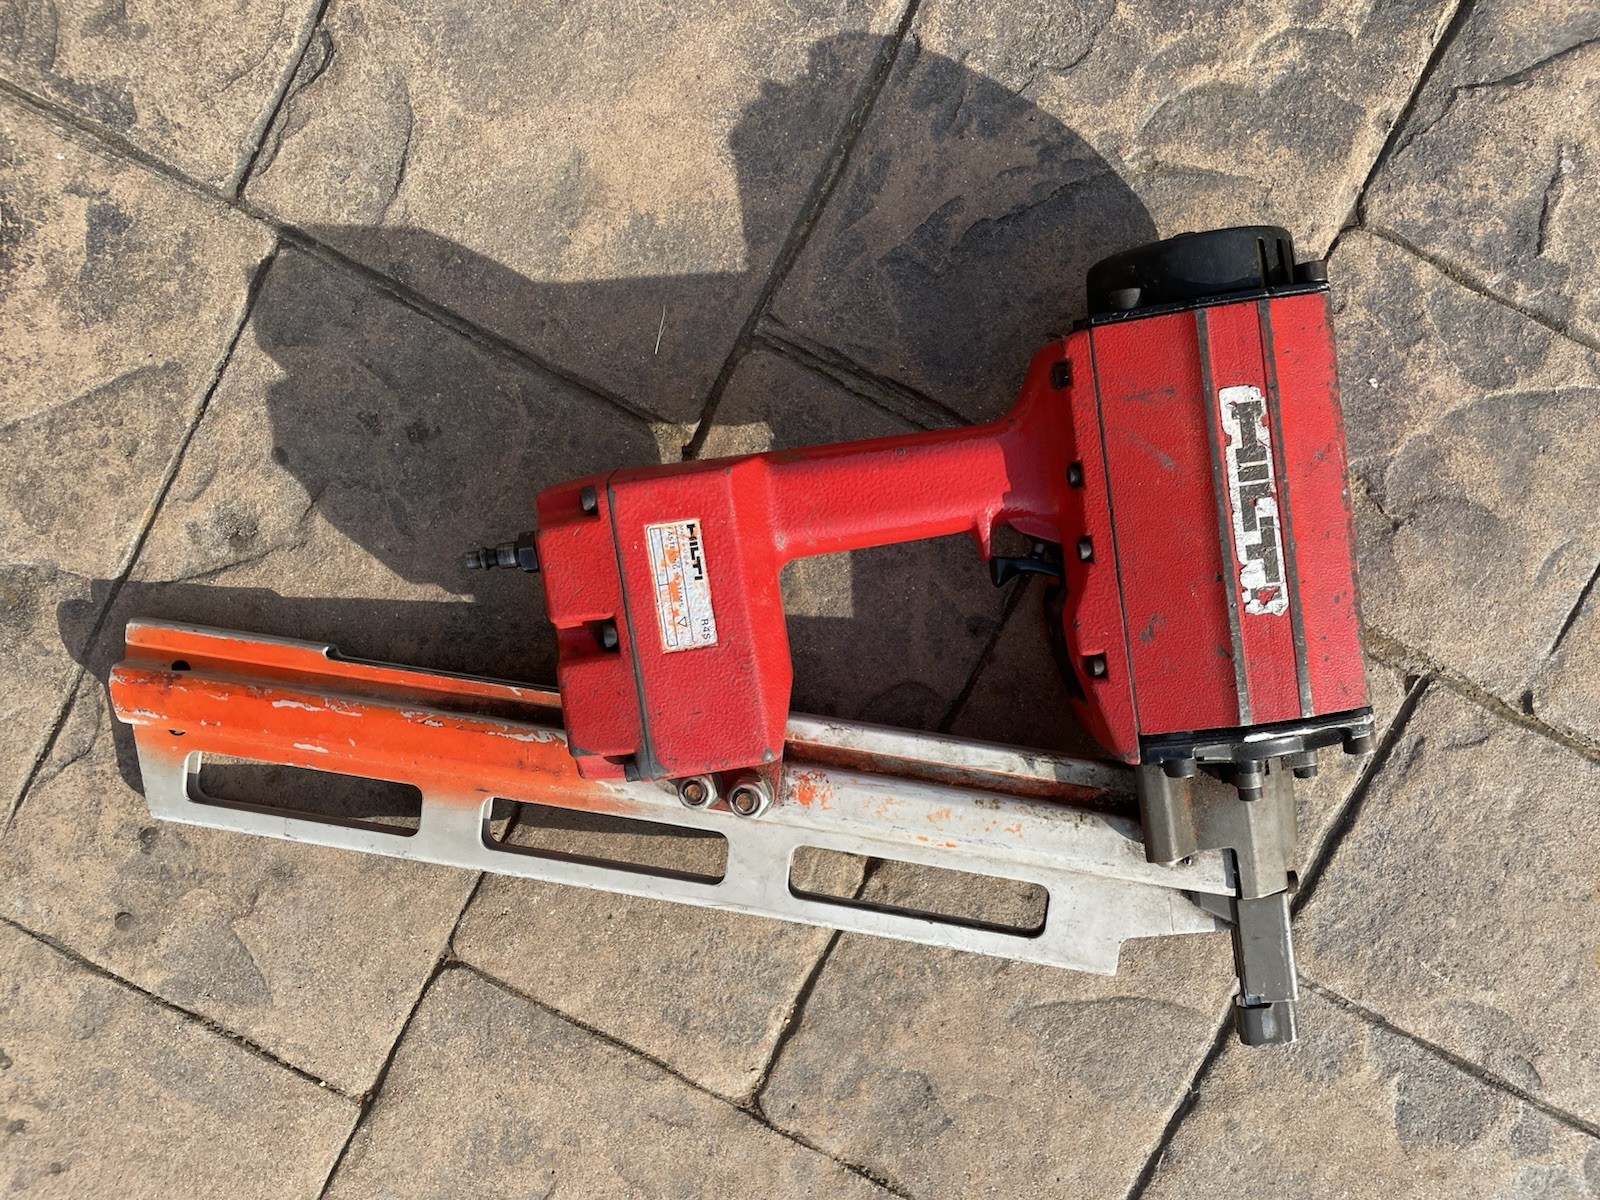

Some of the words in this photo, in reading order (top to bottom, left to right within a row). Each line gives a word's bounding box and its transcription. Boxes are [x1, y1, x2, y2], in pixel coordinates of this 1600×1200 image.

[1231, 400, 1284, 600] HILTI
[687, 523, 703, 581] HILTI
[701, 618, 712, 640] R4S
